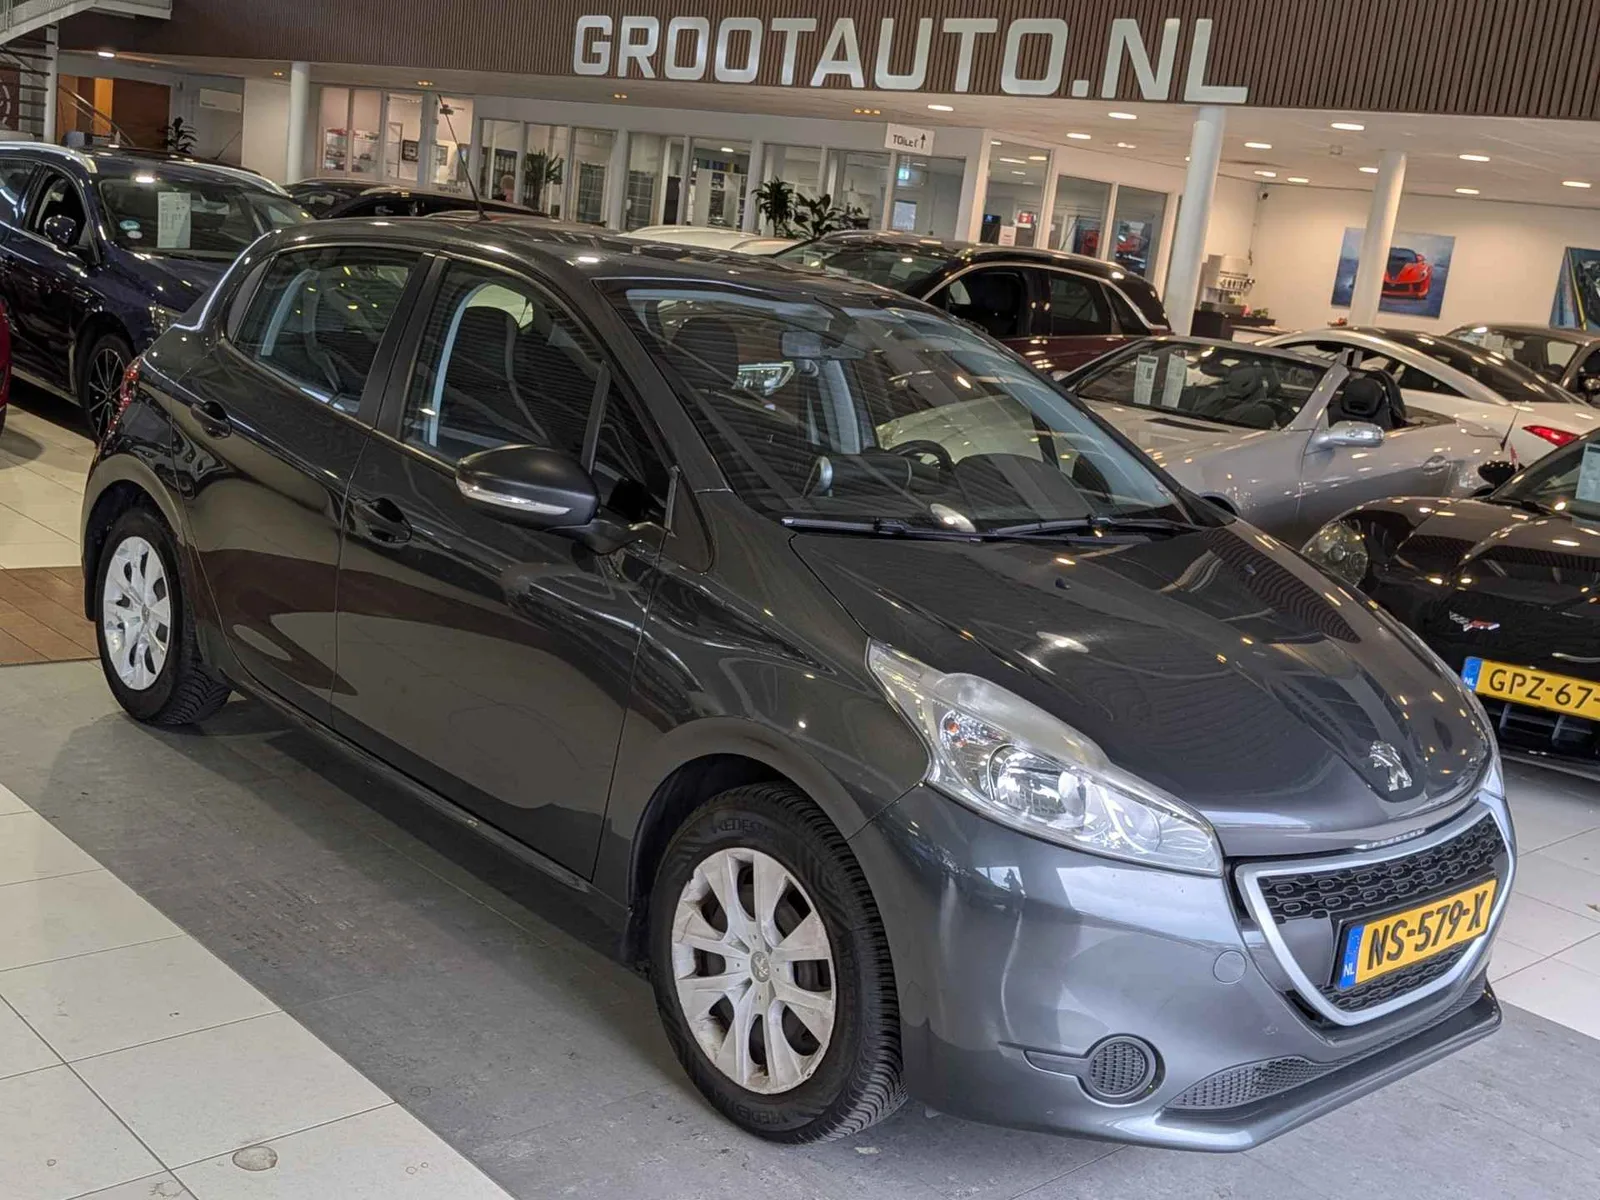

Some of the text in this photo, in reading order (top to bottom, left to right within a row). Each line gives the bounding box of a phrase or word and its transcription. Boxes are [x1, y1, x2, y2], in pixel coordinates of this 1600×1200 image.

[574, 15, 1248, 103] GROOTAUTO.NL
[1464, 676, 1475, 686] NL
[1367, 890, 1488, 970] NS-579-X
[1343, 962, 1355, 977] NL
